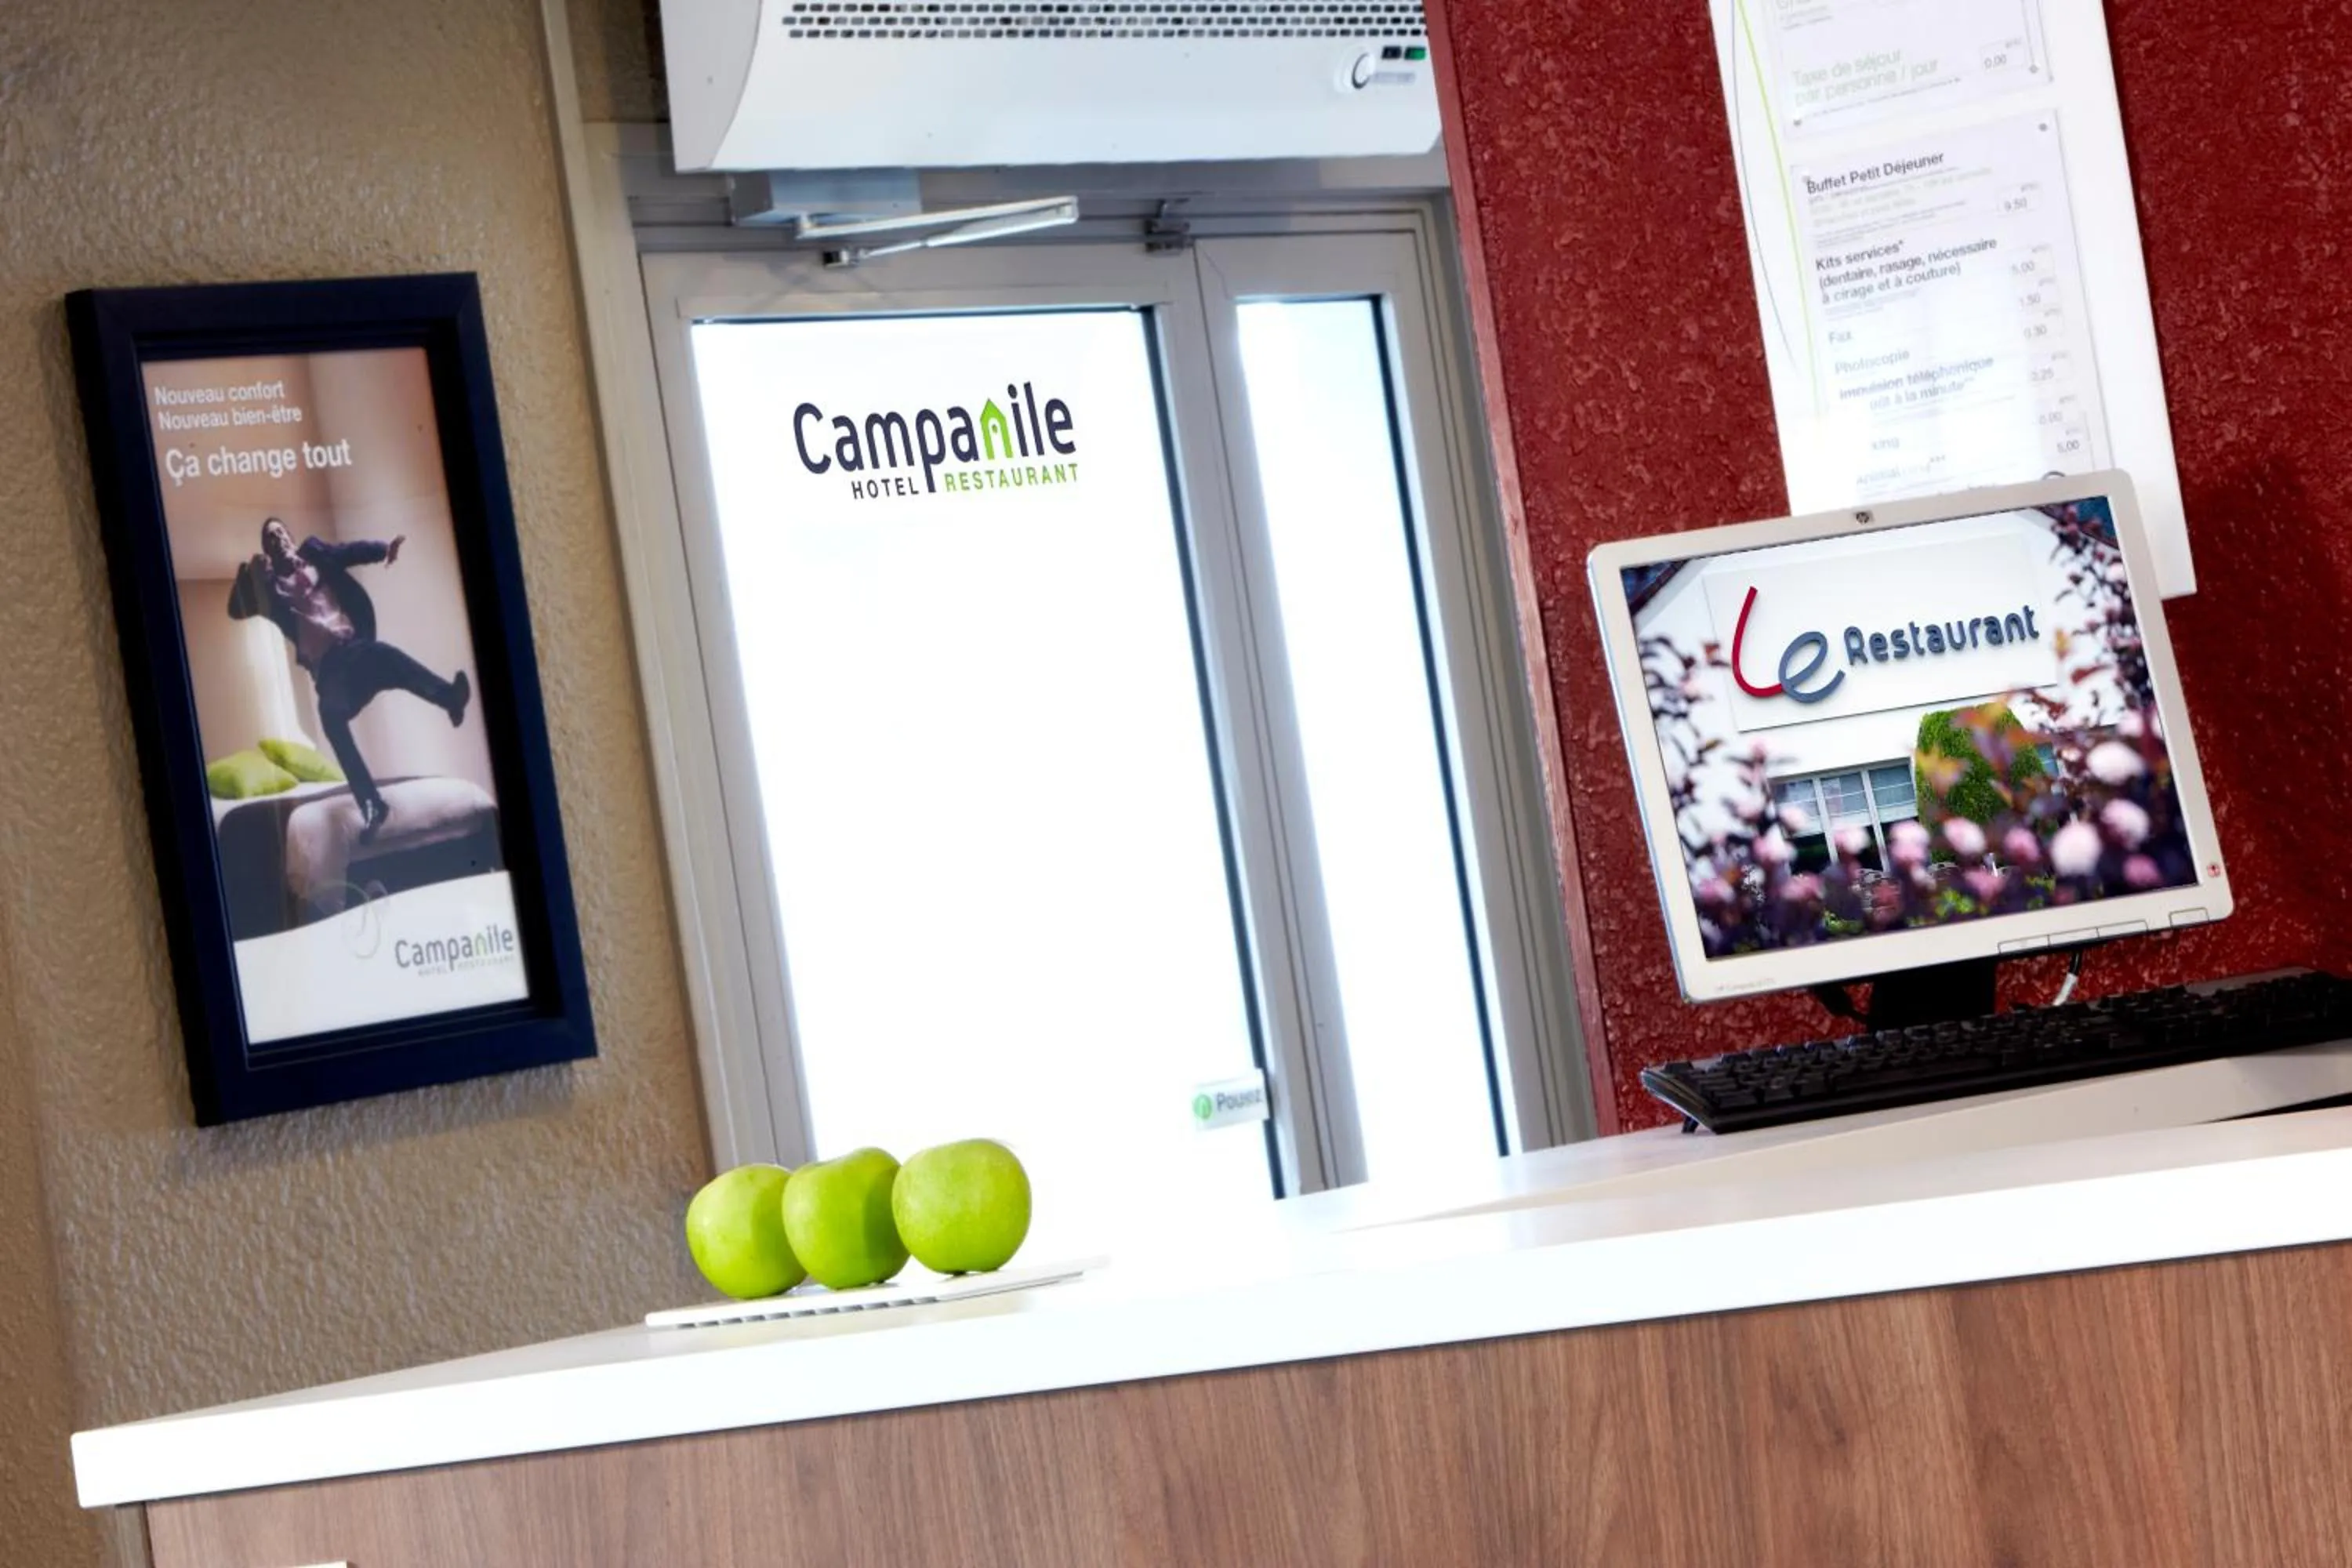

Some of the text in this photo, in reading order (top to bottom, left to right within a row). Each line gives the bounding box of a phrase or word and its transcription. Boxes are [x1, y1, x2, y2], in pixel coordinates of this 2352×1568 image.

[1831, 61, 1852, 78] de
[1806, 152, 1945, 194] Buffet Petit Déjeuner
[1815, 256, 1842, 271] Kits
[1878, 254, 1926, 275] rasage,
[1927, 238, 1998, 263] nécessaire
[1822, 291, 1831, 305] à
[1833, 283, 1875, 300] cirage
[1877, 277, 1891, 291] et
[1893, 274, 1904, 288] à
[1905, 260, 1962, 285] couture)
[154, 379, 285, 405] Nouveau confort
[158, 405, 303, 430] Nouveau bien-être
[793, 380, 1076, 494] Campanile
[165, 437, 353, 487] Ça change tout
[851, 463, 1079, 500] HOTEL RESTAURANT
[1843, 604, 2041, 666] Restaurant
[394, 922, 515, 973] Campanile
